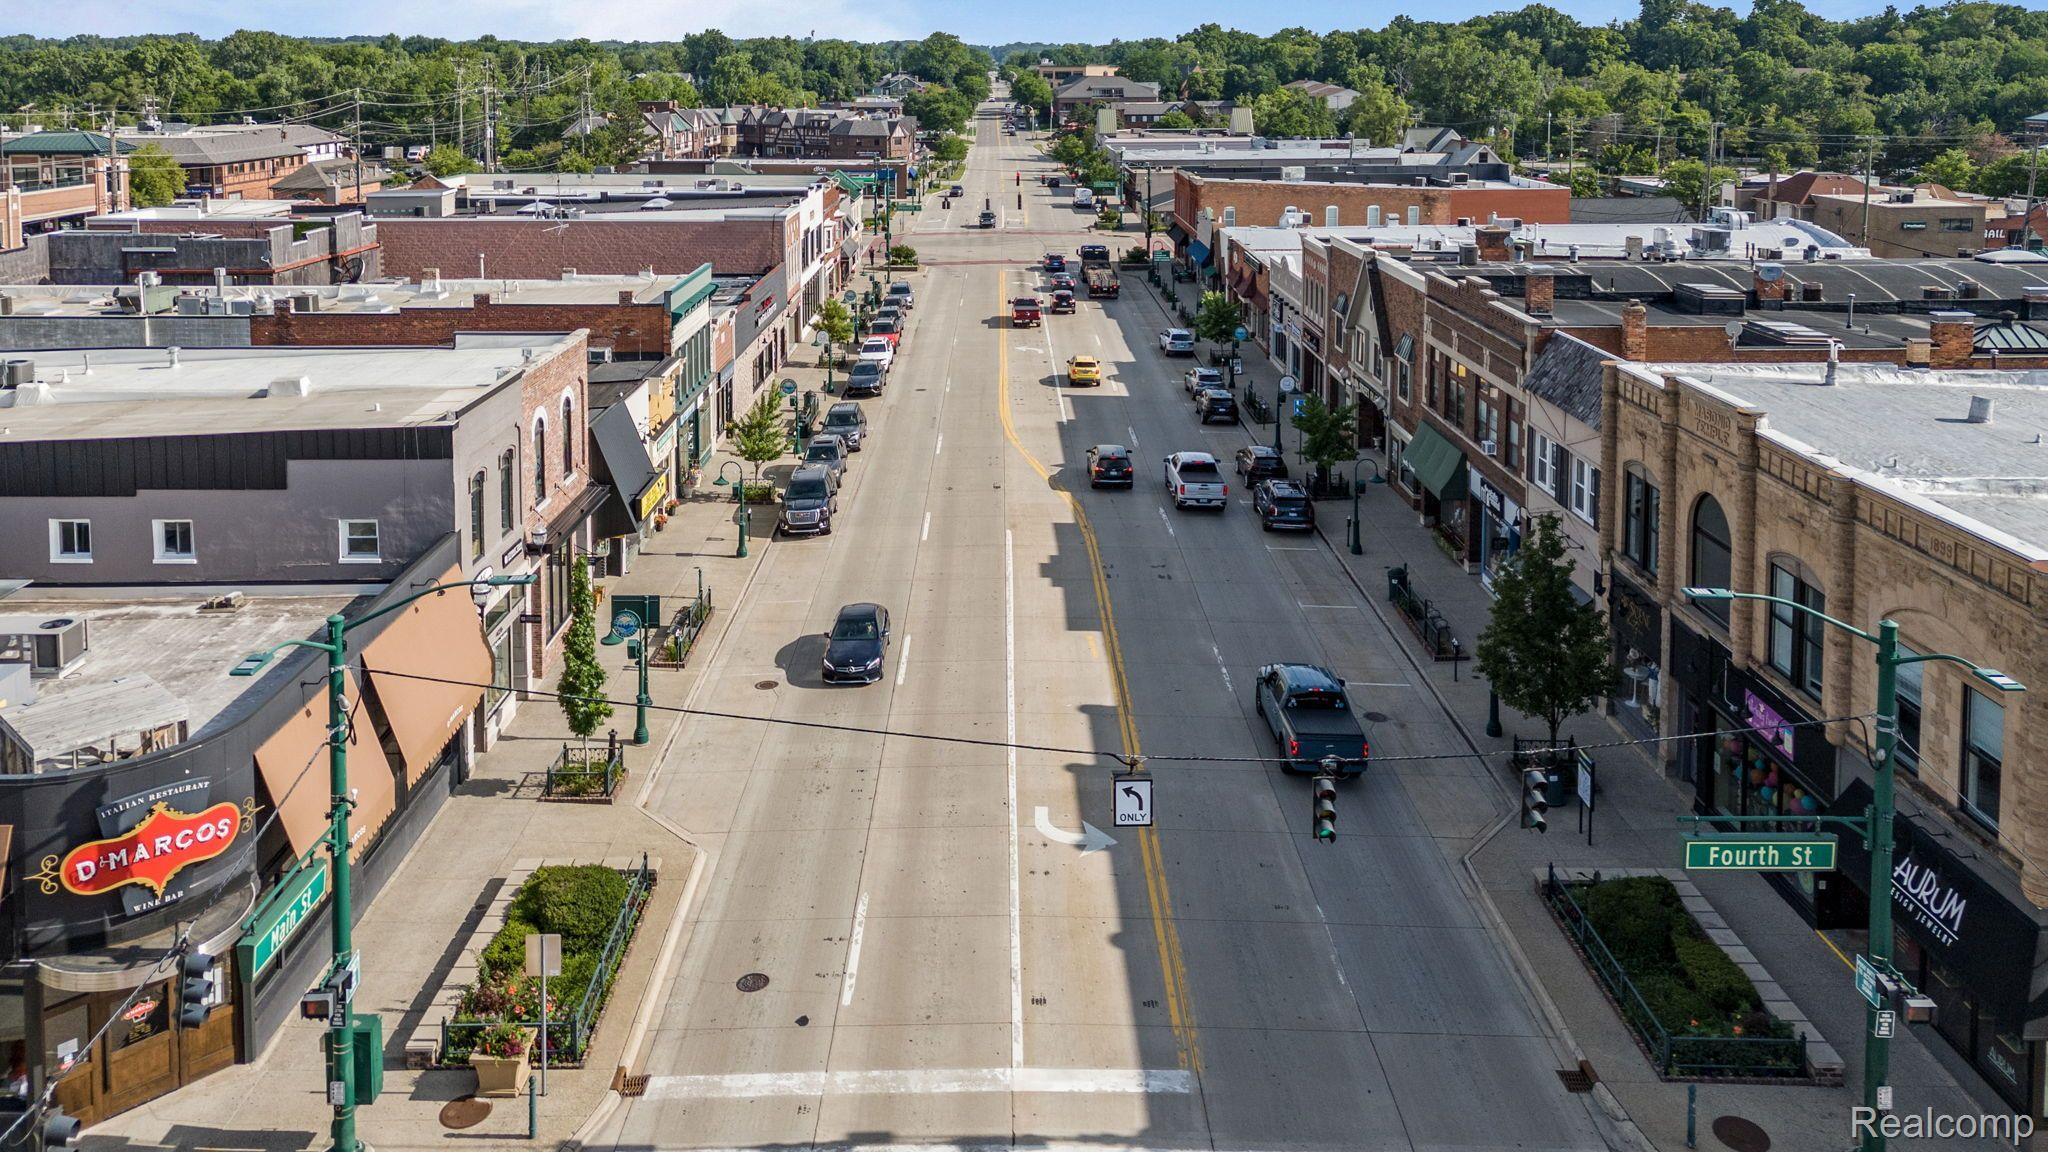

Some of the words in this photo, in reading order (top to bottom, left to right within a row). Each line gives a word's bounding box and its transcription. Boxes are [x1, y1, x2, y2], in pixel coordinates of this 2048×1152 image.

[1930, 535, 1953, 558] 1899
[101, 797, 145, 819] ITALIAN
[149, 781, 210, 801] RESTAURANT
[1120, 813, 1147, 822] ONLY
[1709, 845, 1779, 866] Fourth
[1791, 846, 1813, 866] St
[133, 898, 160, 913] WINE
[165, 890, 184, 903] BAR
[1893, 857, 1967, 932] AURUM
[271, 909, 297, 952] Main
[301, 887, 312, 915] St
[1890, 887, 1914, 912] ESIGN
[1915, 911, 1953, 947] JEWELRY
